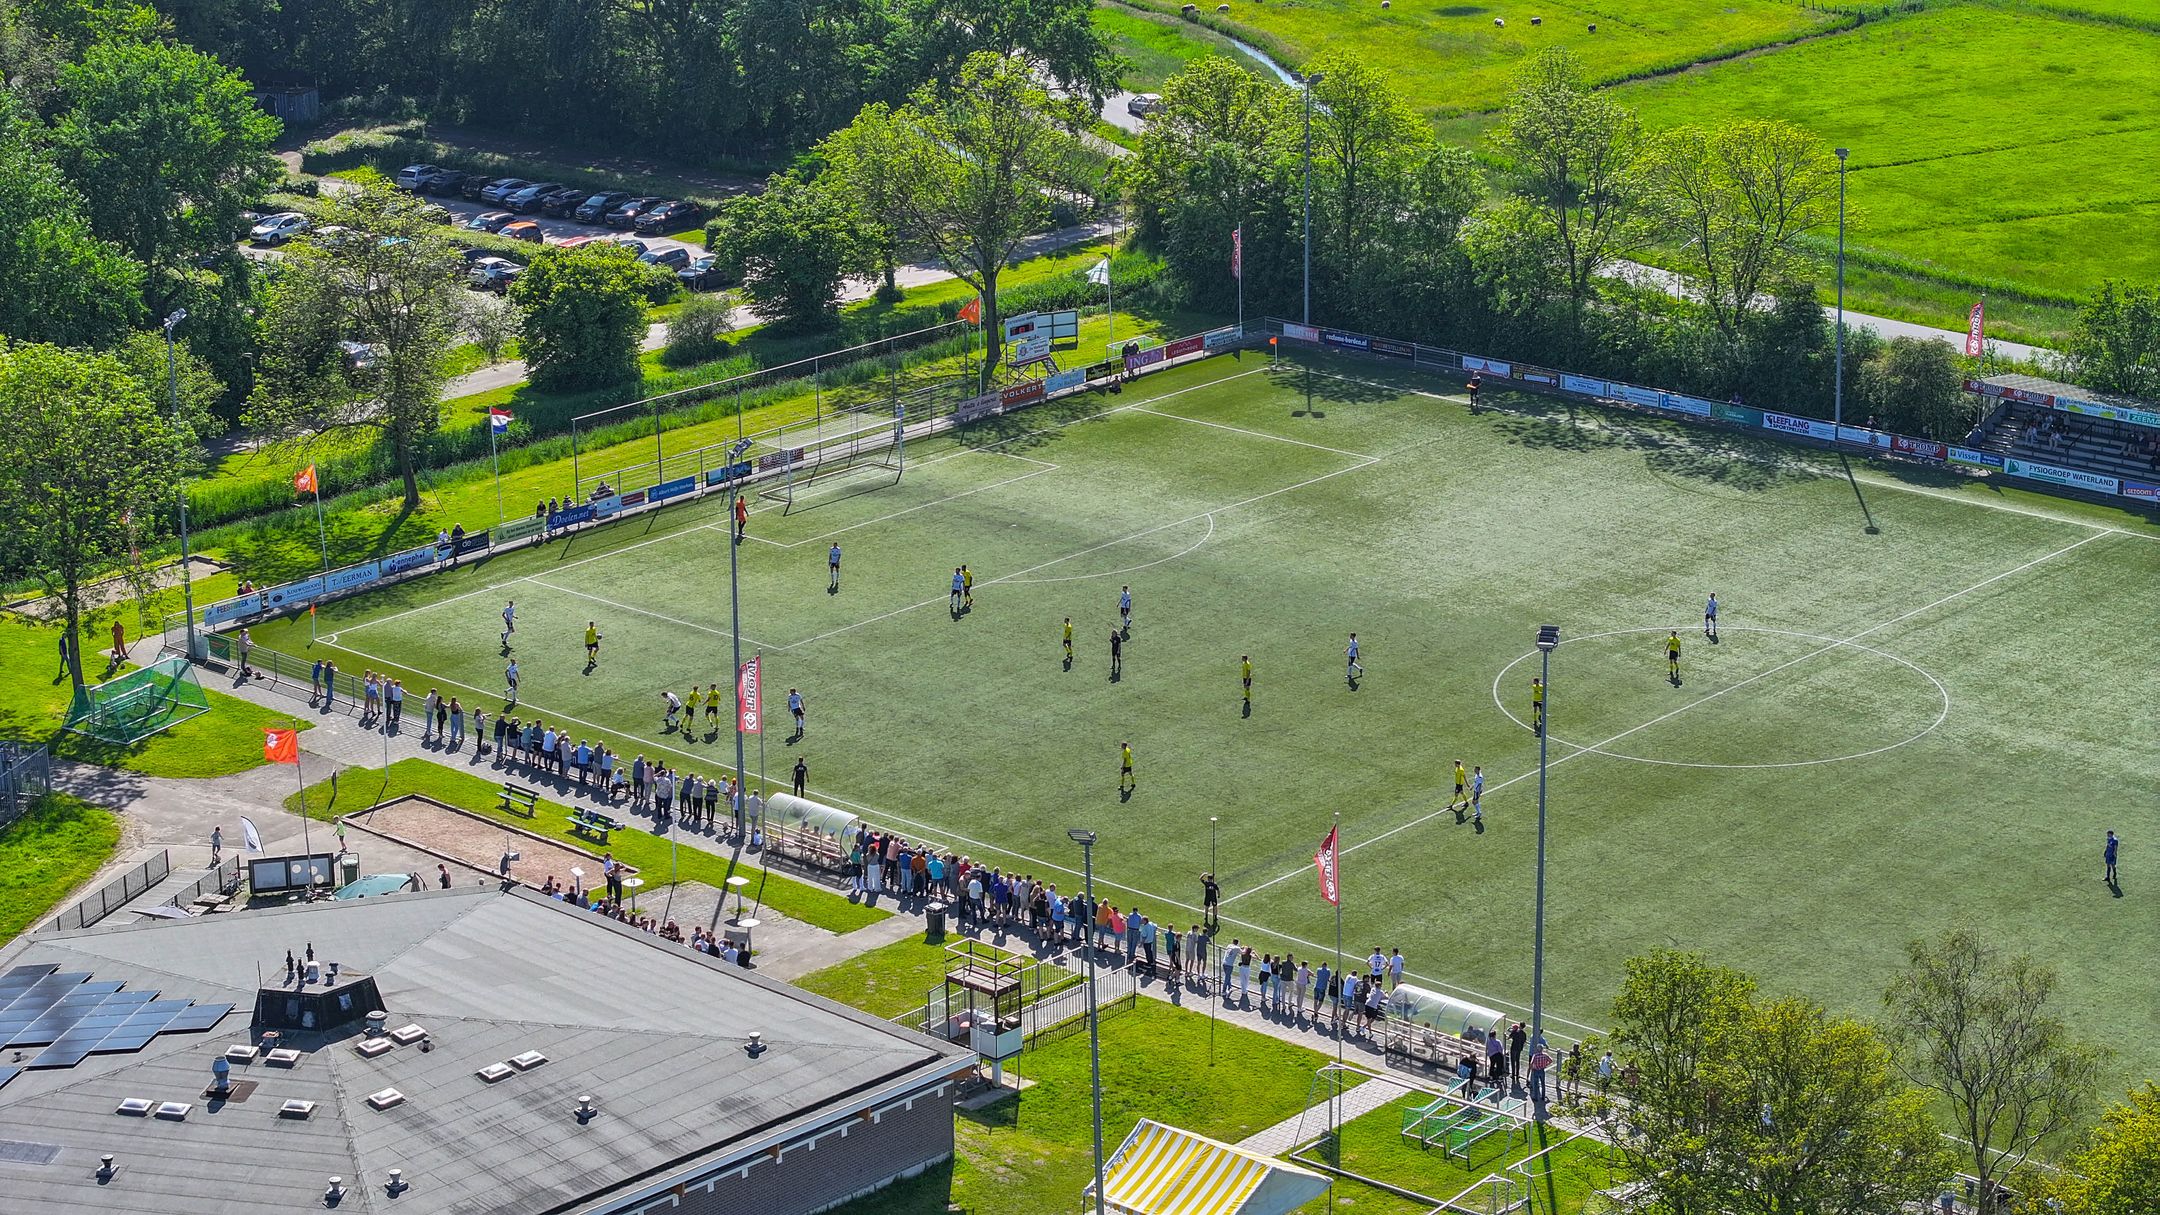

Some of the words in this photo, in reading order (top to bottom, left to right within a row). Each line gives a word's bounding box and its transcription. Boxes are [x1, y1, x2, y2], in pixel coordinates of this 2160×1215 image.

[1129, 356, 1148, 368] ING
[1003, 384, 1043, 399] VOLKERT
[1773, 415, 1809, 430] LEEFLANG
[1773, 423, 1809, 435] SPORTPRIJZEN
[1909, 441, 1941, 454] TROMP
[1957, 450, 1979, 461] Visser
[2029, 465, 2071, 479] FYSIOGROEP
[2072, 473, 2114, 487] WATERLAND
[552, 510, 589, 527] Doelen.net
[217, 599, 249, 614] FEESTWEEK
[1374, 960, 1381, 968] 17
